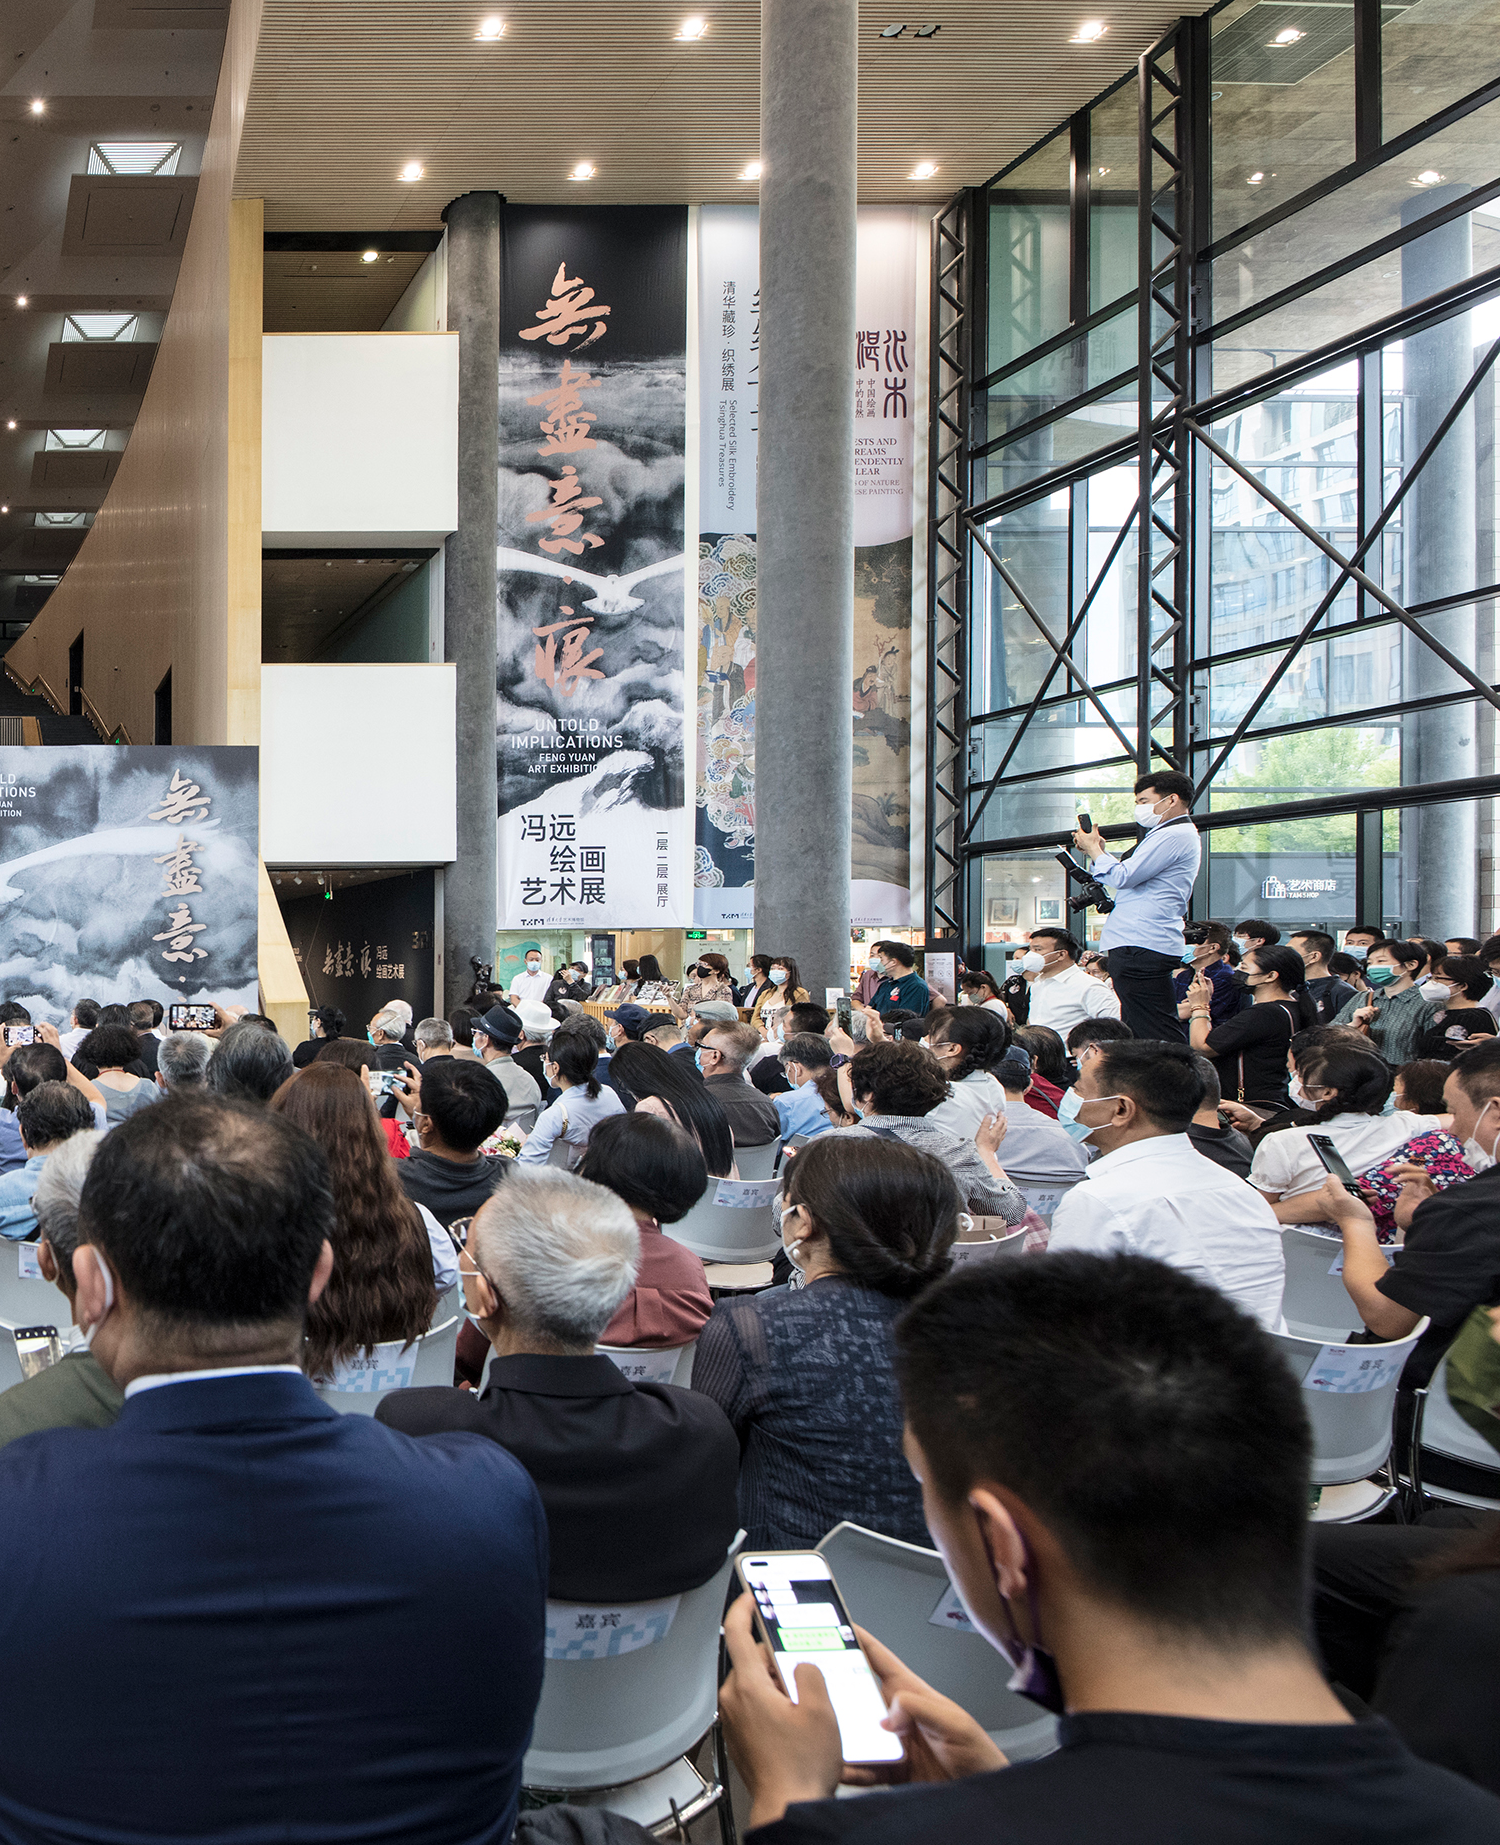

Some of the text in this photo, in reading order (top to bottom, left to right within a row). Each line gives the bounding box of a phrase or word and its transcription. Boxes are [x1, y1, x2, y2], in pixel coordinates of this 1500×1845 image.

[729, 400, 737, 438] Selected
[717, 400, 727, 488] Tsinghua Treasures
[876, 438, 897, 446] AND
[726, 458, 737, 511] Embroidery
[535, 718, 599, 732] UNTOLD
[511, 735, 624, 749] IMPLICATIONS
[539, 752, 596, 762] FENG YUAN
[528, 765, 547, 773] ART
[520, 813, 576, 842] 冯远
[549, 845, 607, 874] 绘画
[520, 876, 607, 906] 艺术展
[1289, 879, 1337, 891] 艺术商店
[575, 1612, 622, 1629] 嘉宾
